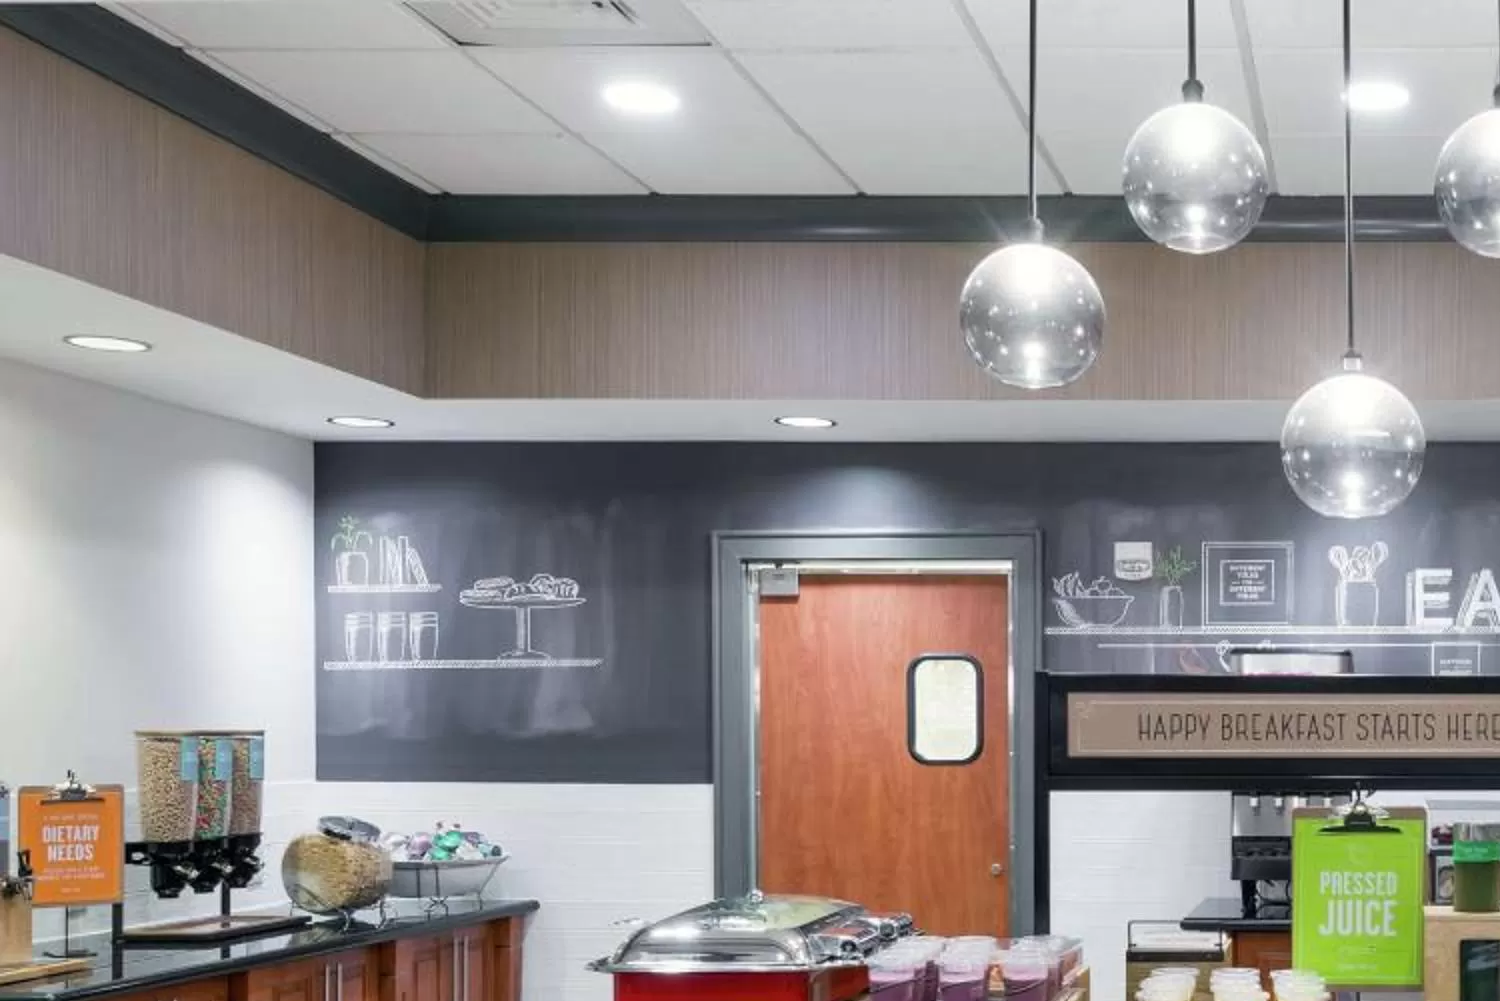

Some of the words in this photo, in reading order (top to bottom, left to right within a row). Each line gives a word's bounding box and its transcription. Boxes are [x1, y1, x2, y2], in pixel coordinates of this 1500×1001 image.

[1137, 712, 1211, 742] HAPPY
[1220, 712, 1347, 742] BREAKFAST
[1355, 712, 1437, 742] STARTS
[42, 824, 100, 843] DIETARY
[47, 843, 94, 863] NEEDS
[1319, 870, 1398, 897] PRESSED
[1318, 898, 1398, 937] JUICE
